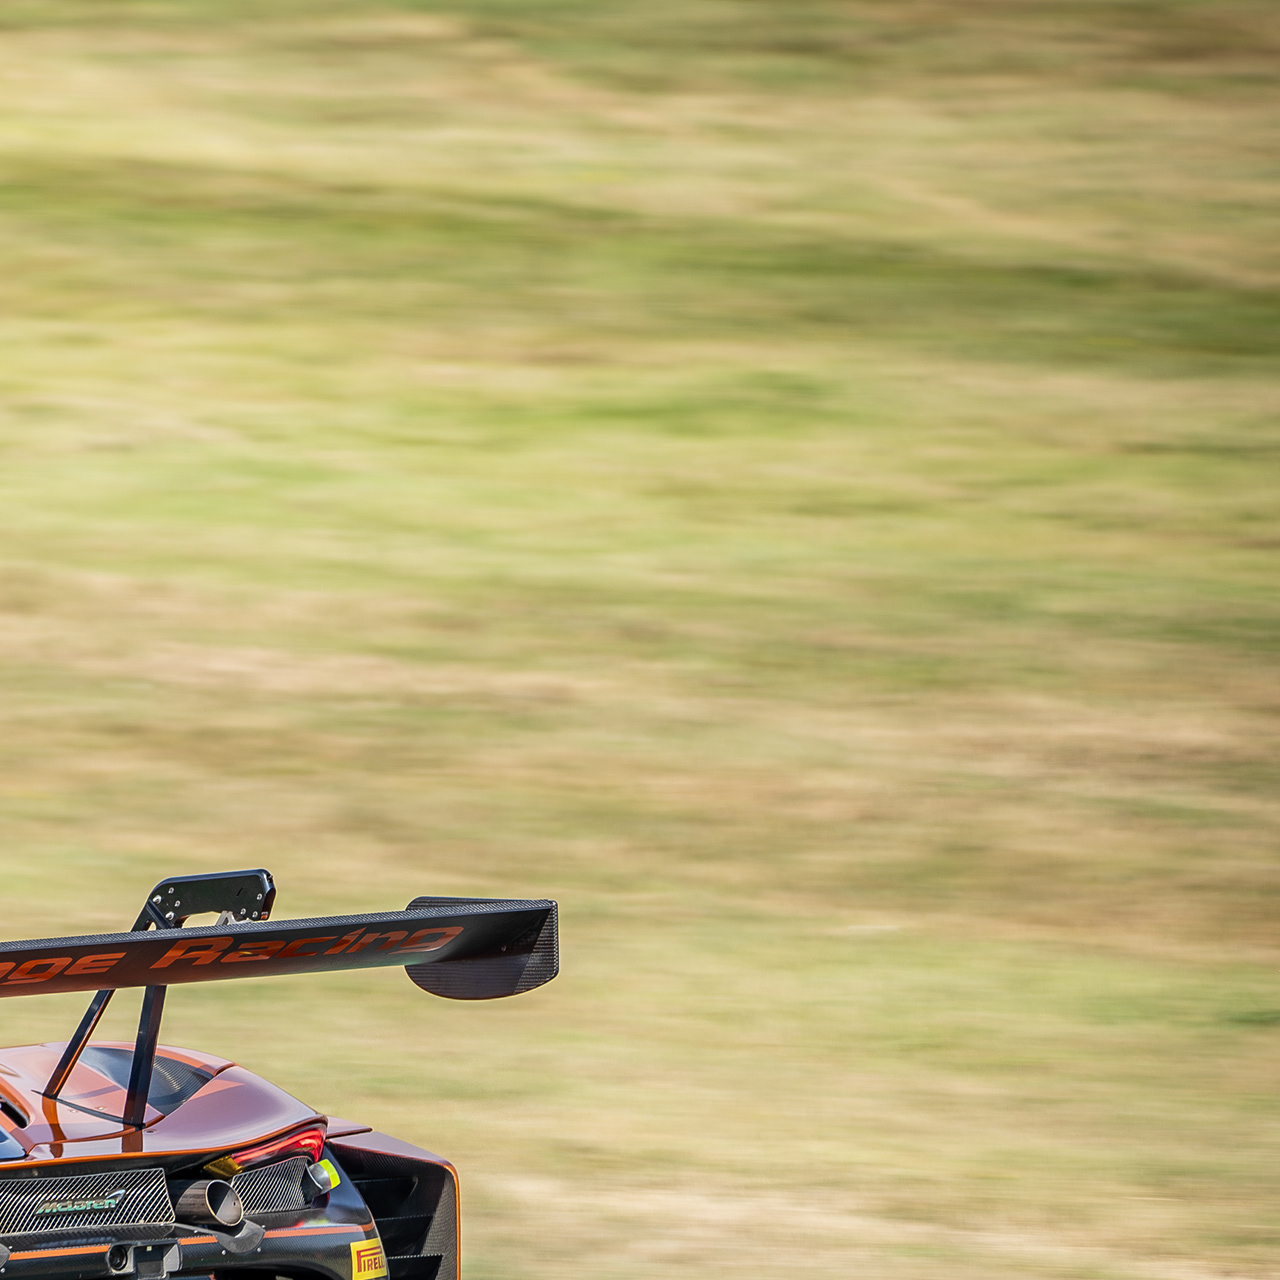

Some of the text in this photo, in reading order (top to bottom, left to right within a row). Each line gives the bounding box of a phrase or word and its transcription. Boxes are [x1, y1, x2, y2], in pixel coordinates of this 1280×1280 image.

[149, 927, 464, 969] Racing
[35, 1198, 117, 1215] McLaren
[356, 1245, 386, 1273] PIRELL
